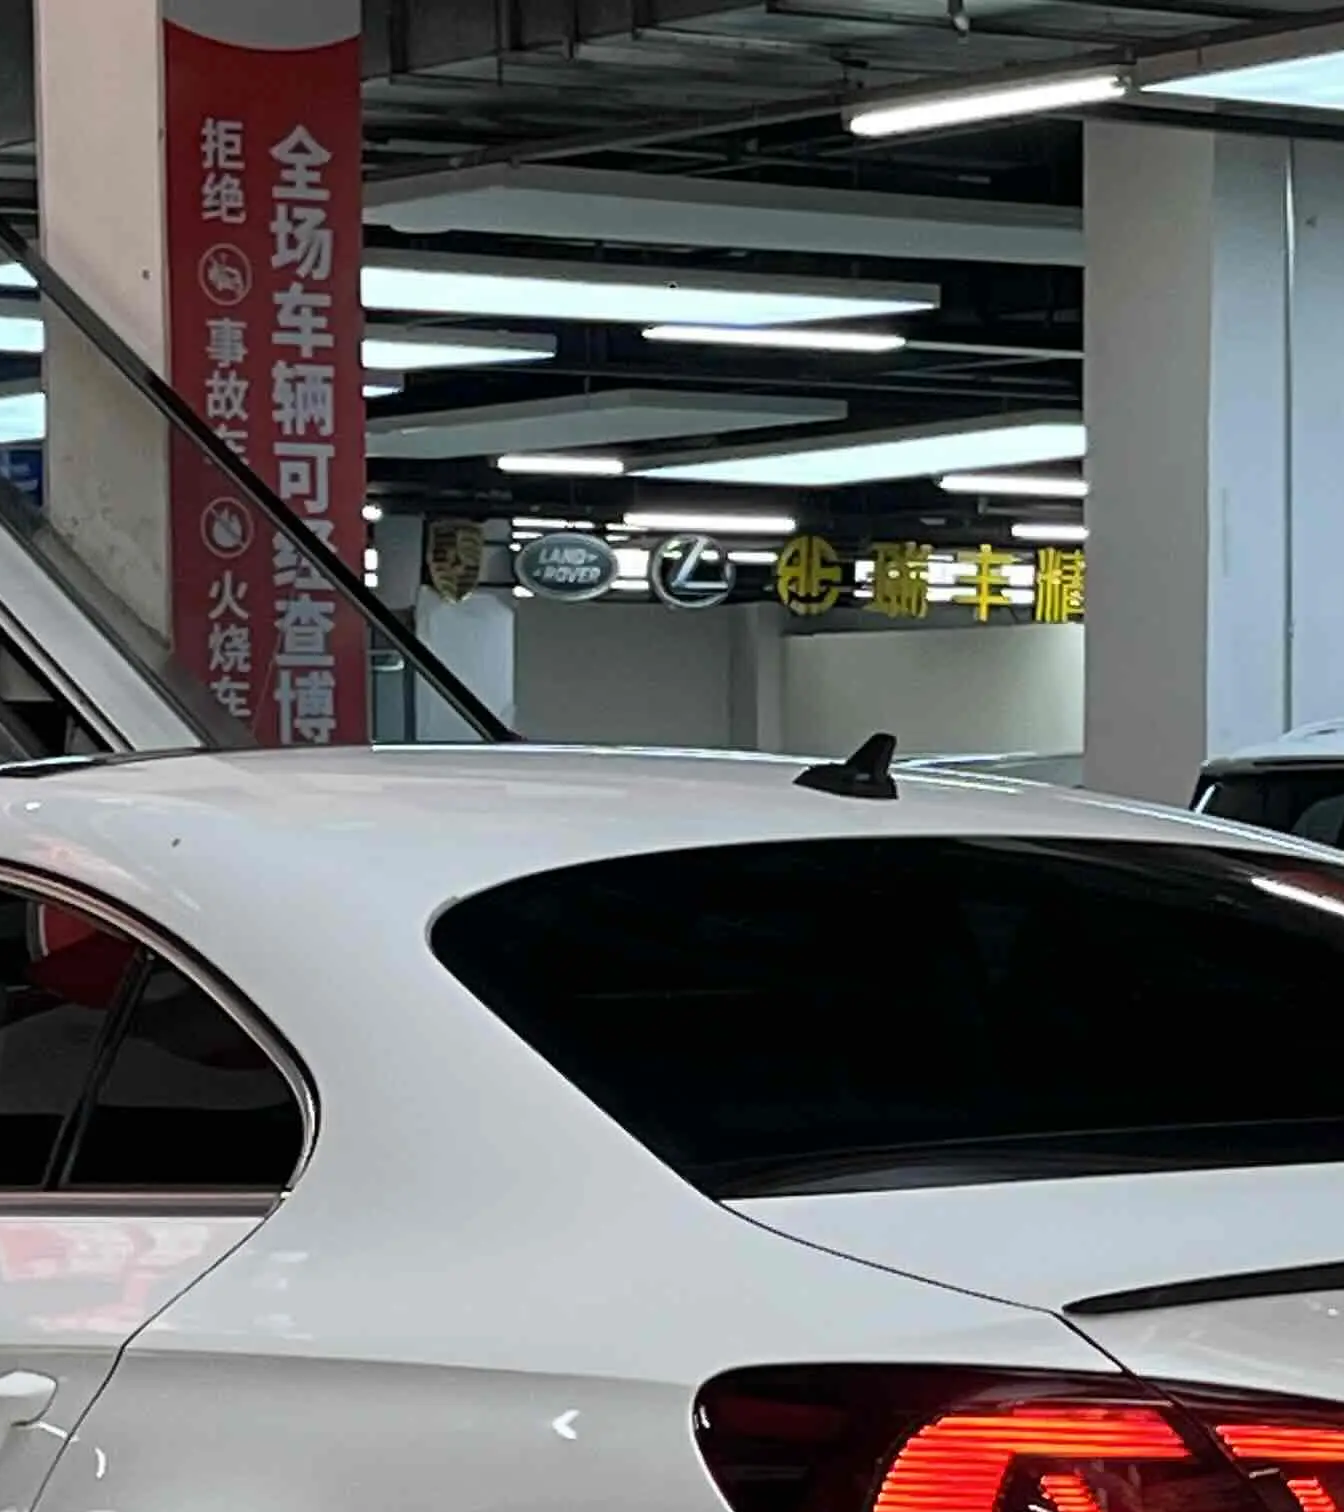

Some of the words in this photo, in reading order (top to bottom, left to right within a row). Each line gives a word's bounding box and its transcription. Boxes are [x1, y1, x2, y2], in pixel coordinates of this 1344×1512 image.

[200, 117, 248, 224] 拒绝
[538, 548, 586, 566] LAND
[543, 565, 602, 583] ROVER
